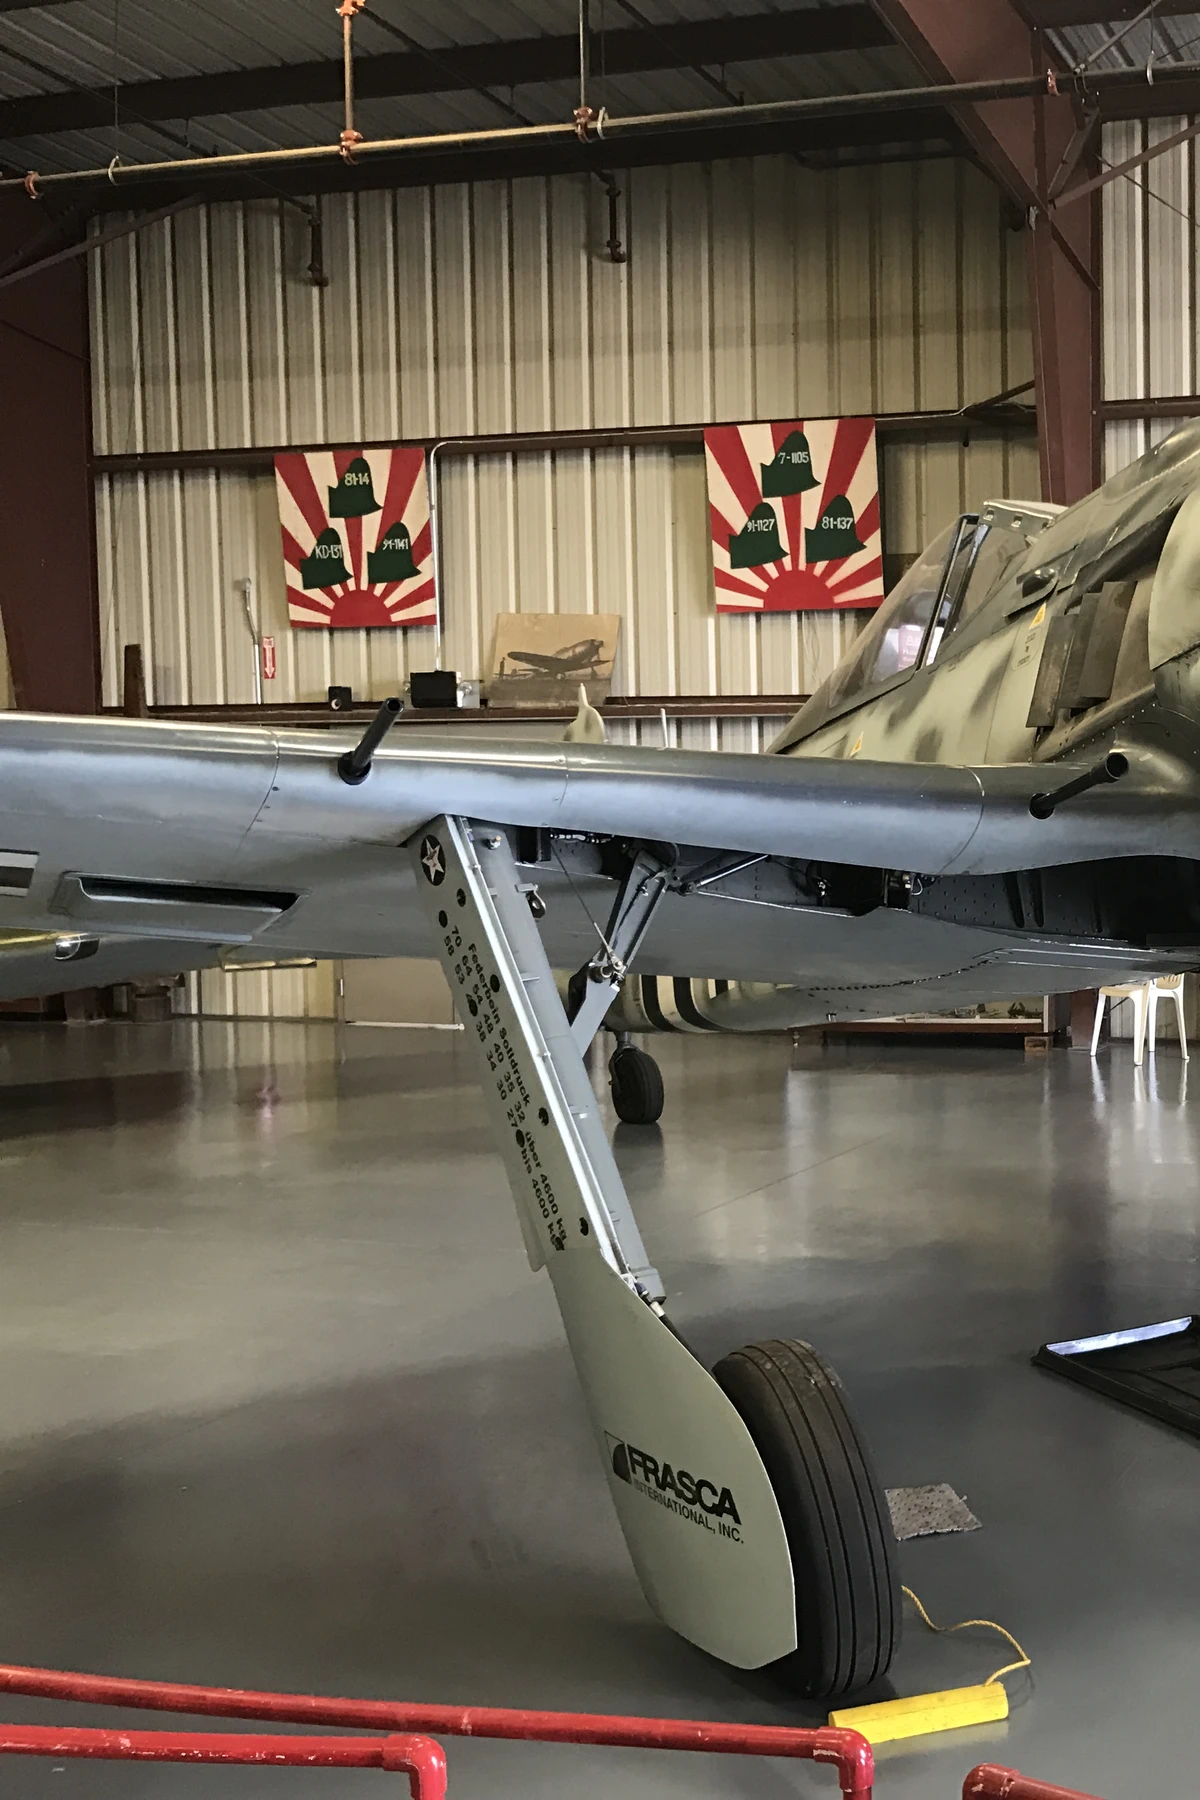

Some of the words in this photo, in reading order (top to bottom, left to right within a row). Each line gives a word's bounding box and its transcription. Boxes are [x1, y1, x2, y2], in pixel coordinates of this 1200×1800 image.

[778, 452, 810, 464] 7-1105
[451, 925, 462, 947] 70
[494, 1042, 504, 1063] 40
[504, 1071, 515, 1093] 35
[514, 1101, 525, 1123] 32
[540, 1173, 559, 1214] 4600
[468, 943, 500, 1024] Federbein
[499, 1027, 531, 1107] Solldruck
[487, 1050, 497, 1071] 34
[497, 1079, 507, 1100] 30
[507, 1108, 518, 1128] 27
[532, 1178, 549, 1219] 4600
[626, 1444, 742, 1525] FRASCA
[718, 1521, 744, 1544] INC.
